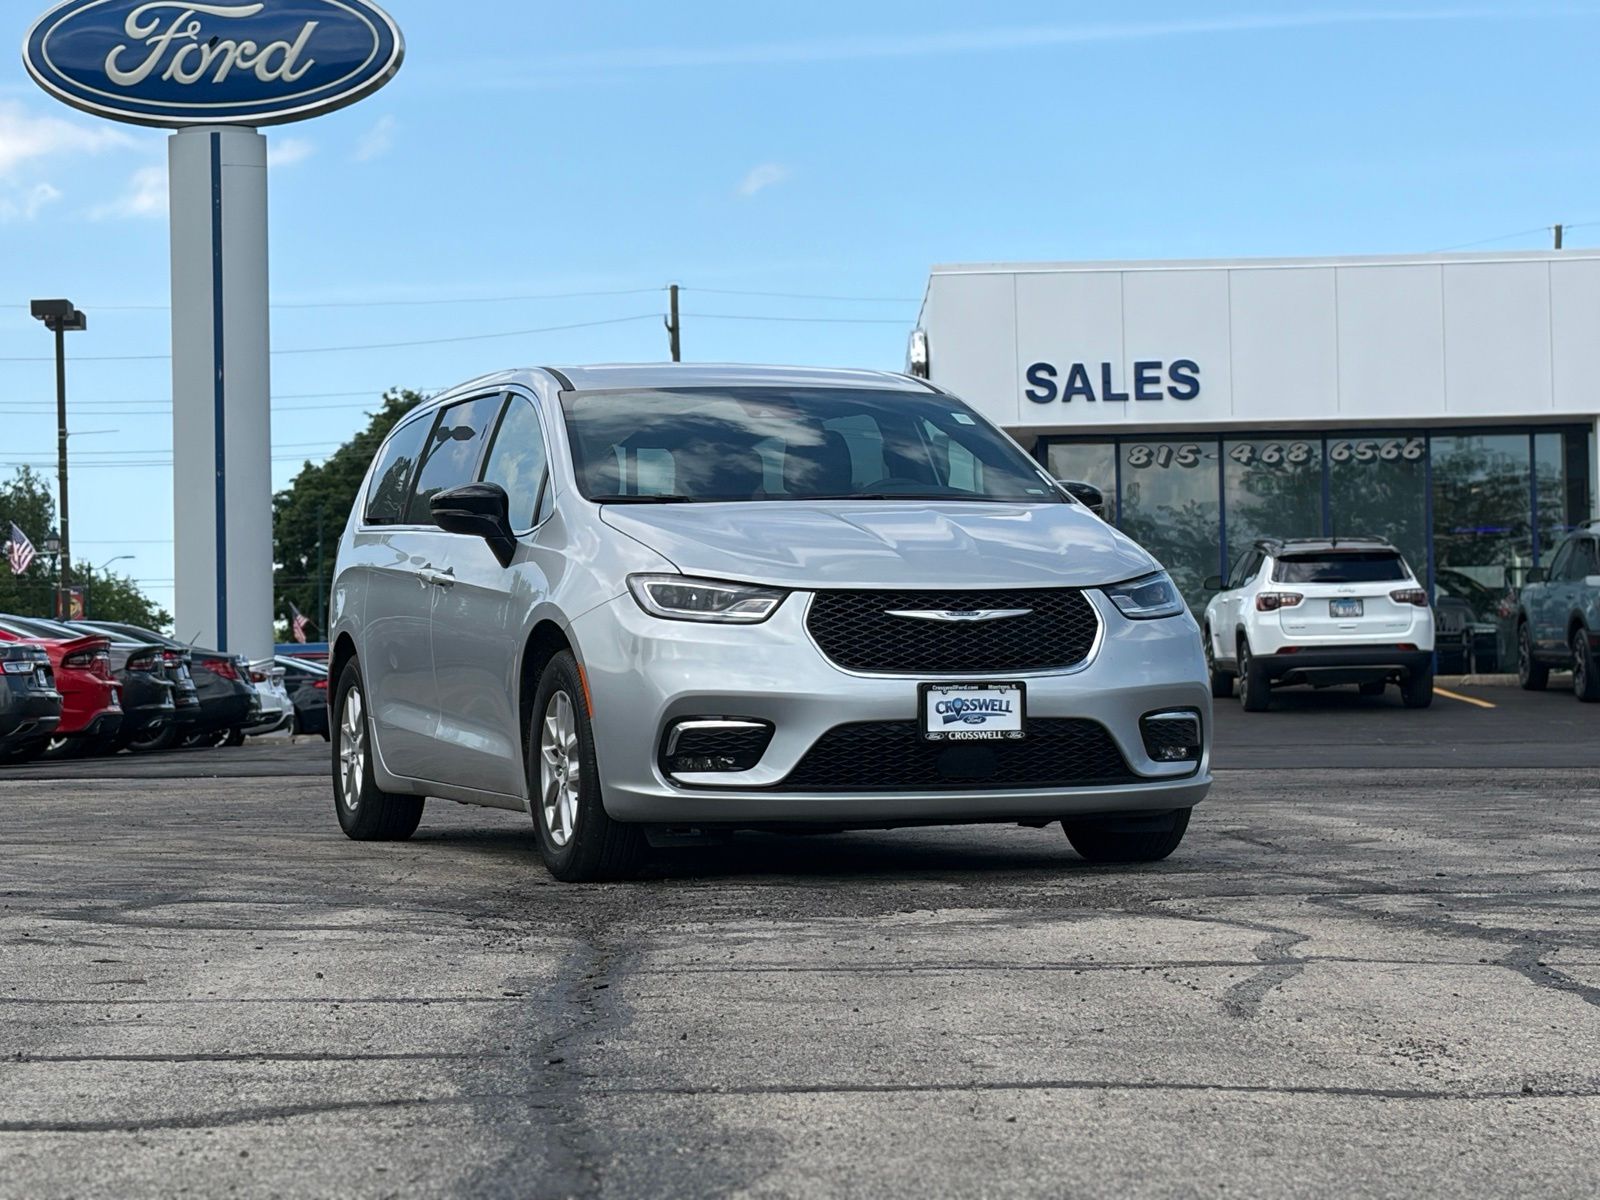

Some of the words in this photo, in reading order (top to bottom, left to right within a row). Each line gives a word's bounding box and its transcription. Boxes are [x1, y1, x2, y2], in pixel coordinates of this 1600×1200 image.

[105, 2, 319, 86] Ford
[1025, 359, 1200, 404] SALES
[1330, 439, 1425, 462] 6566
[935, 698, 1012, 715] CROSSWELL
[948, 731, 1004, 740] CROSSWELL
